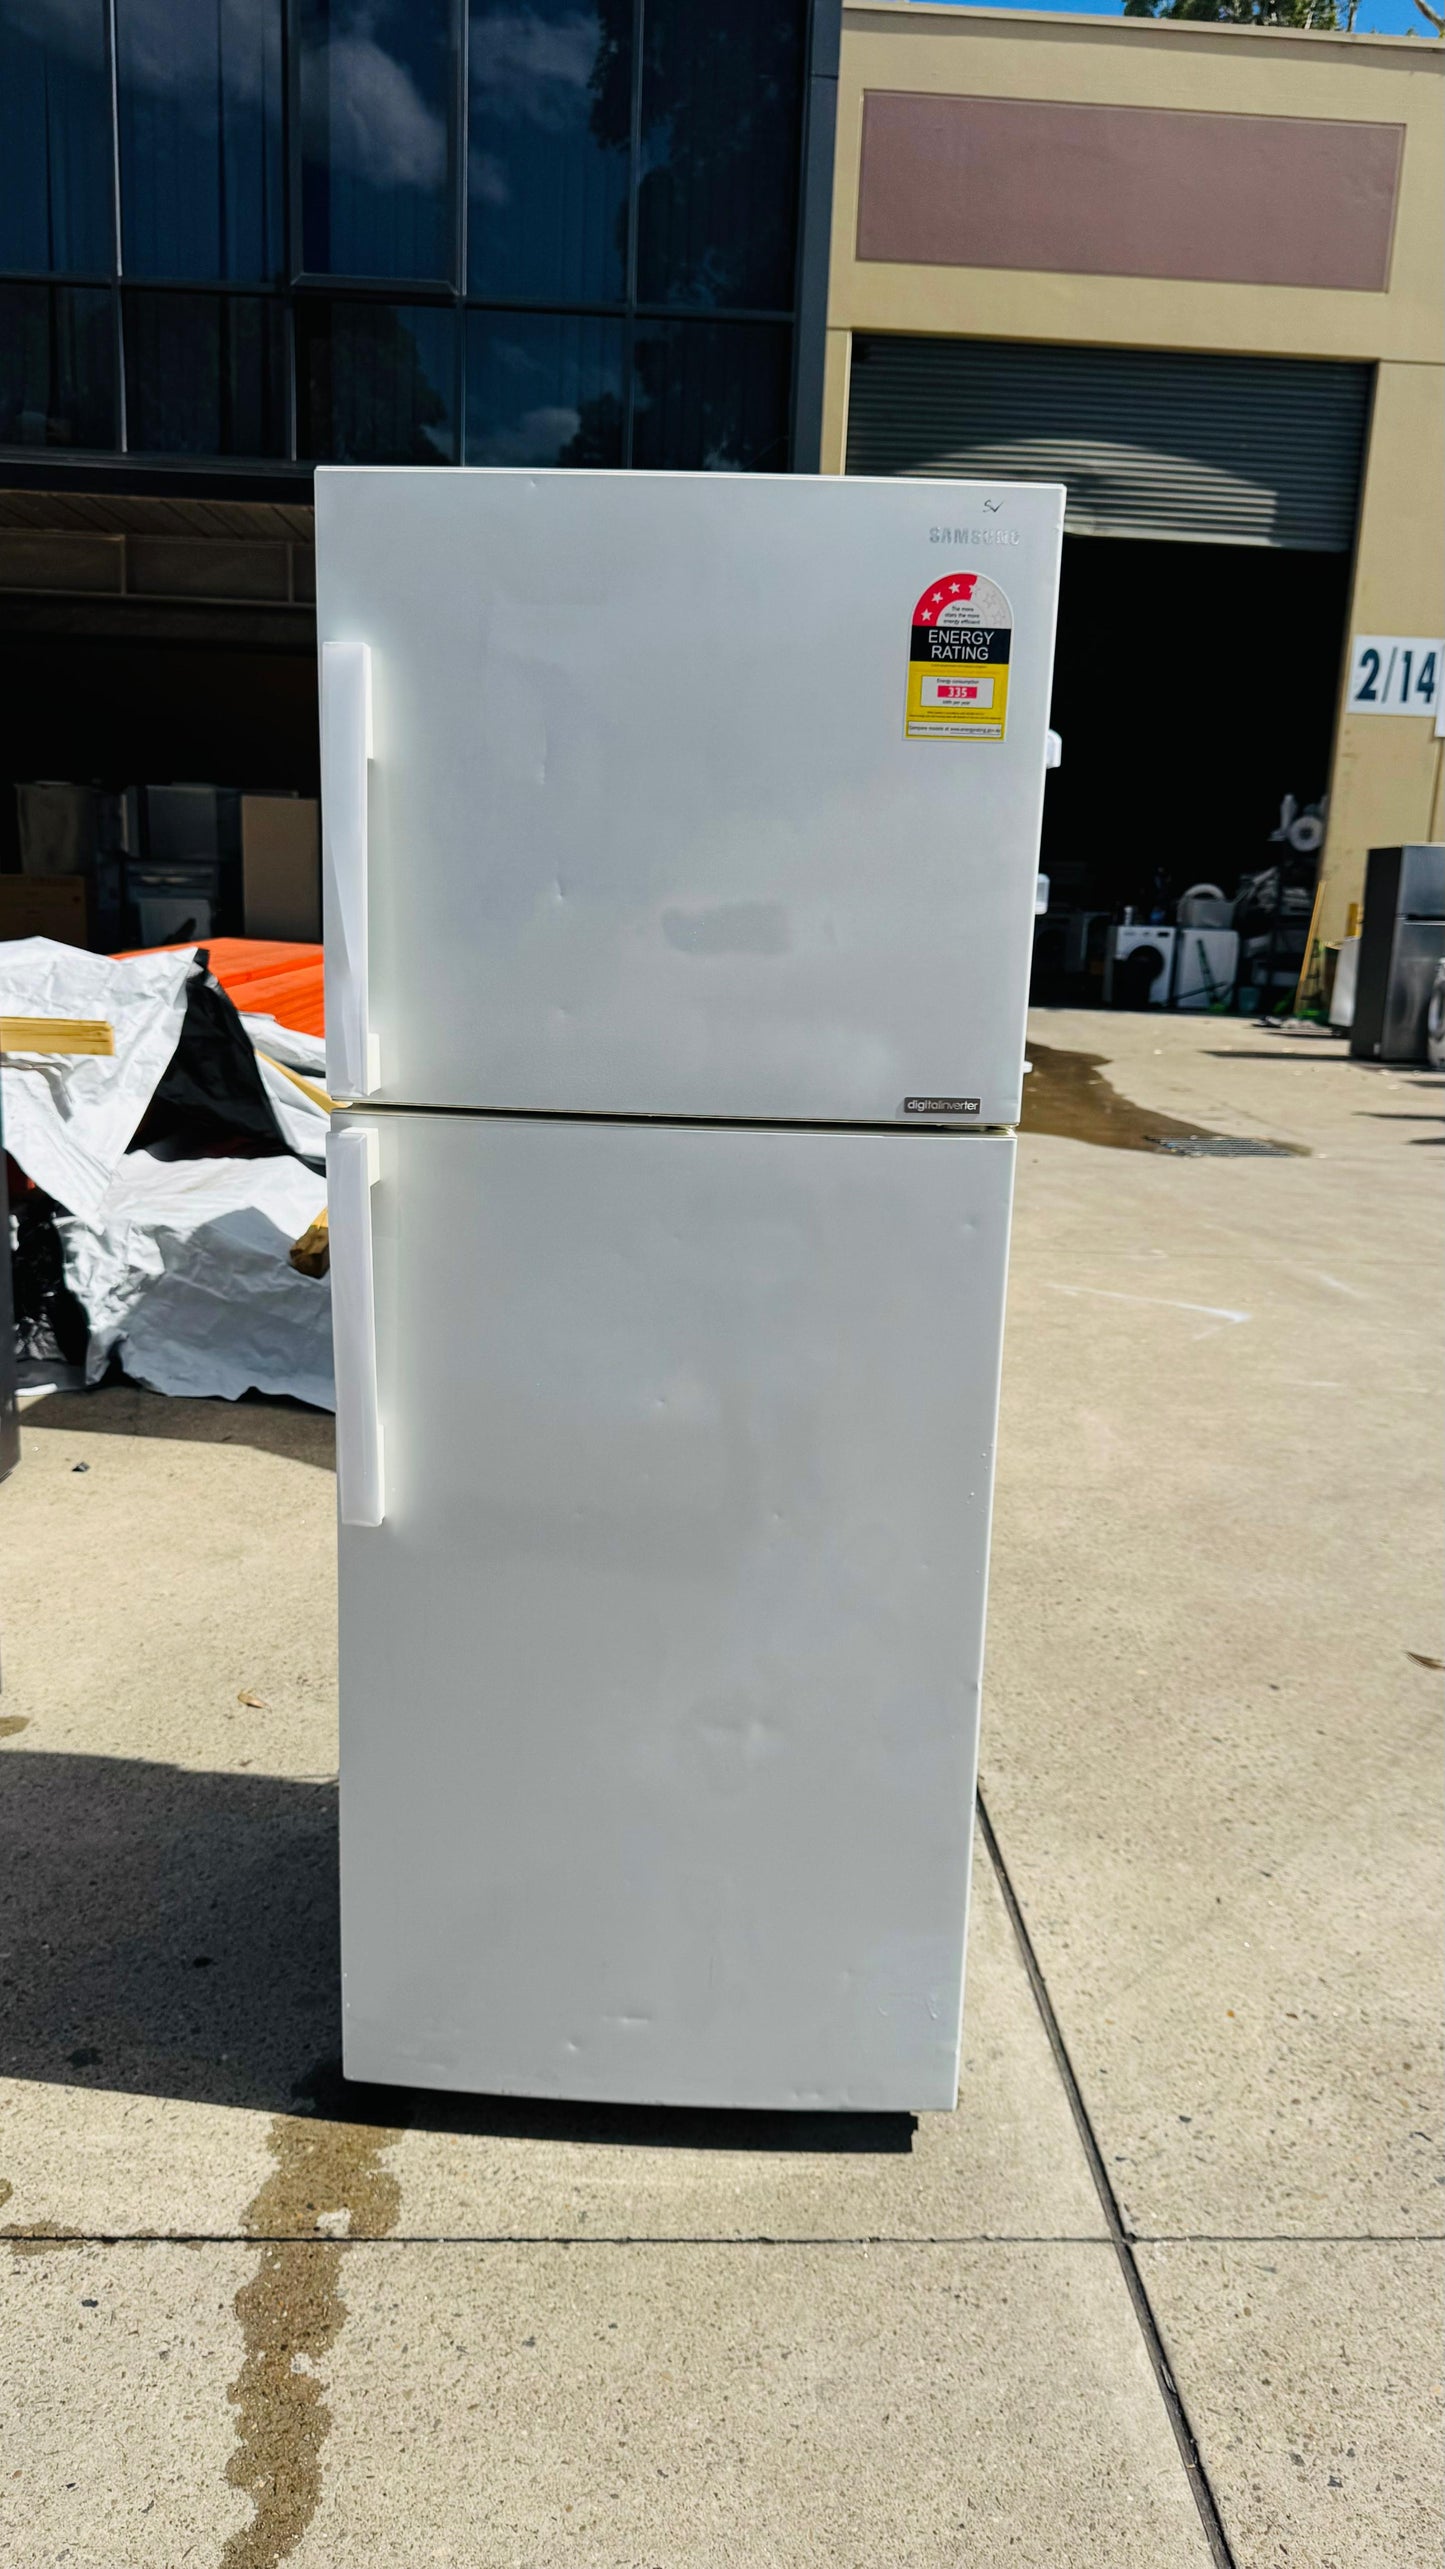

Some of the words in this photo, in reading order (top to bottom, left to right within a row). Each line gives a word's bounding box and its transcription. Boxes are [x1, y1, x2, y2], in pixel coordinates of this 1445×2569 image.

[929, 527, 1021, 545] SAMSUNG
[928, 629, 995, 645] ENERGY
[931, 645, 989, 661] RATING
[1355, 647, 1436, 704] 2/14
[948, 687, 967, 698] 335
